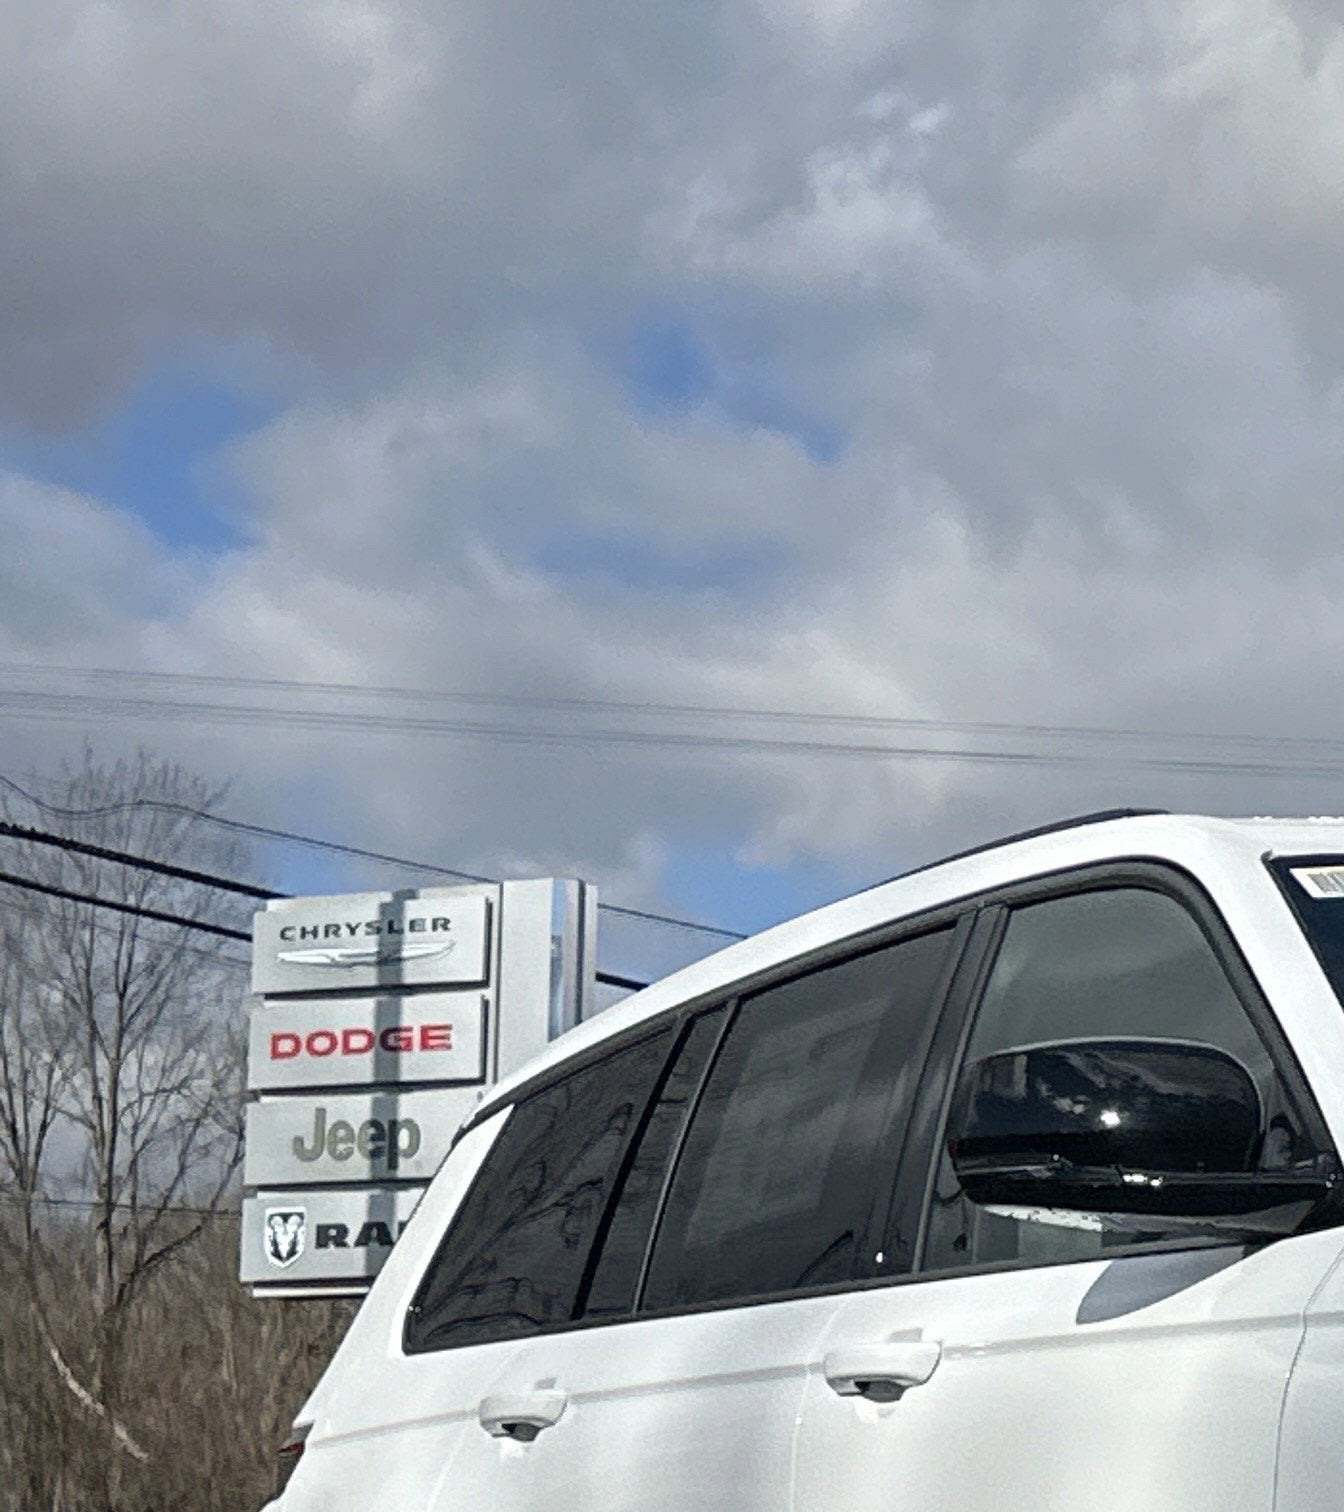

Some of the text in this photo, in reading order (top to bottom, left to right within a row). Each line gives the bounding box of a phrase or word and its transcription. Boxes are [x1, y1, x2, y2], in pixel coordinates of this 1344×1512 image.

[279, 915, 452, 942] CHRYSLER
[269, 1023, 453, 1060] DODGE
[291, 1107, 422, 1170] Jeep
[315, 1220, 409, 1249] RA
